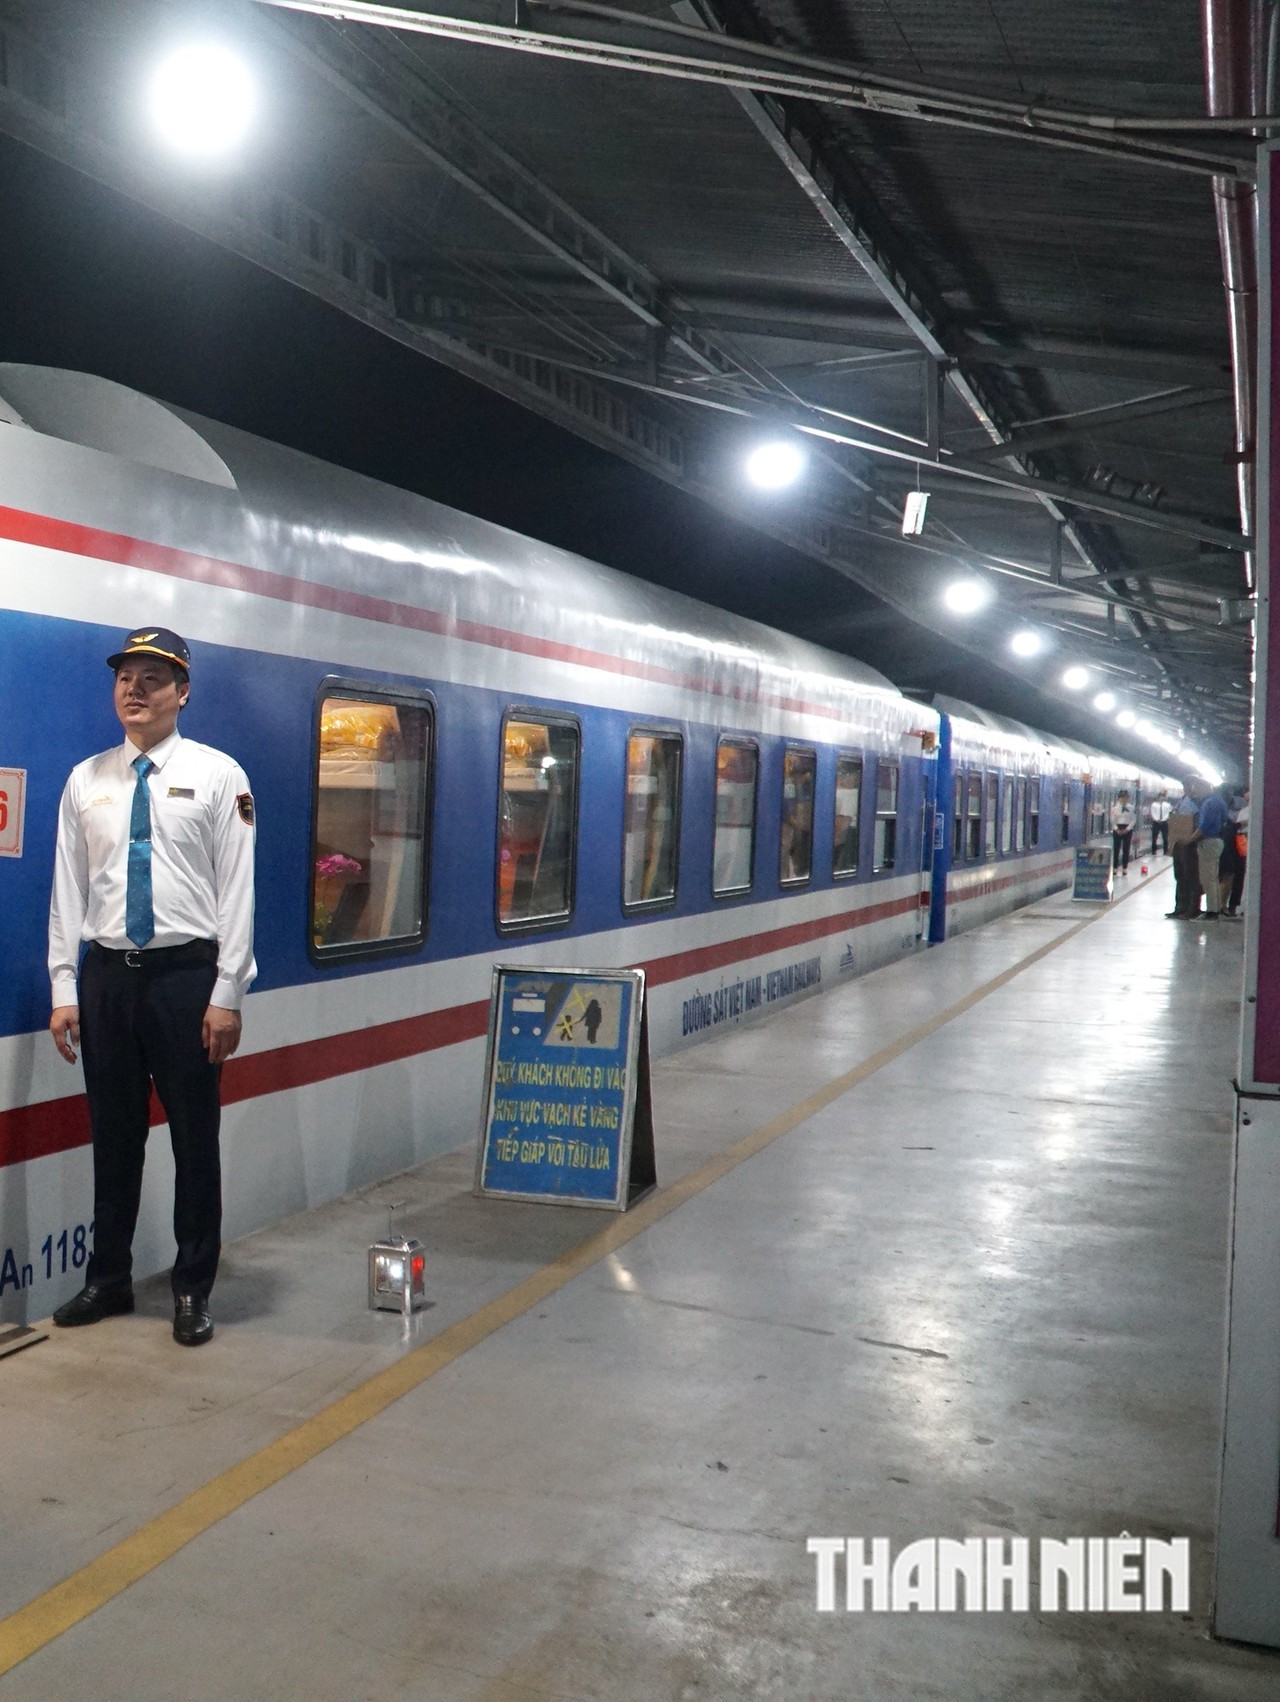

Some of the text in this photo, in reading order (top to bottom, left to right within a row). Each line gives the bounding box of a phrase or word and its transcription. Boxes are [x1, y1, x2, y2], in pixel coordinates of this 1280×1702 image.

[518, 1057, 553, 1087] KHÁCH
[555, 1061, 592, 1089] KHÔNG
[593, 1066, 605, 1089] ĐI
